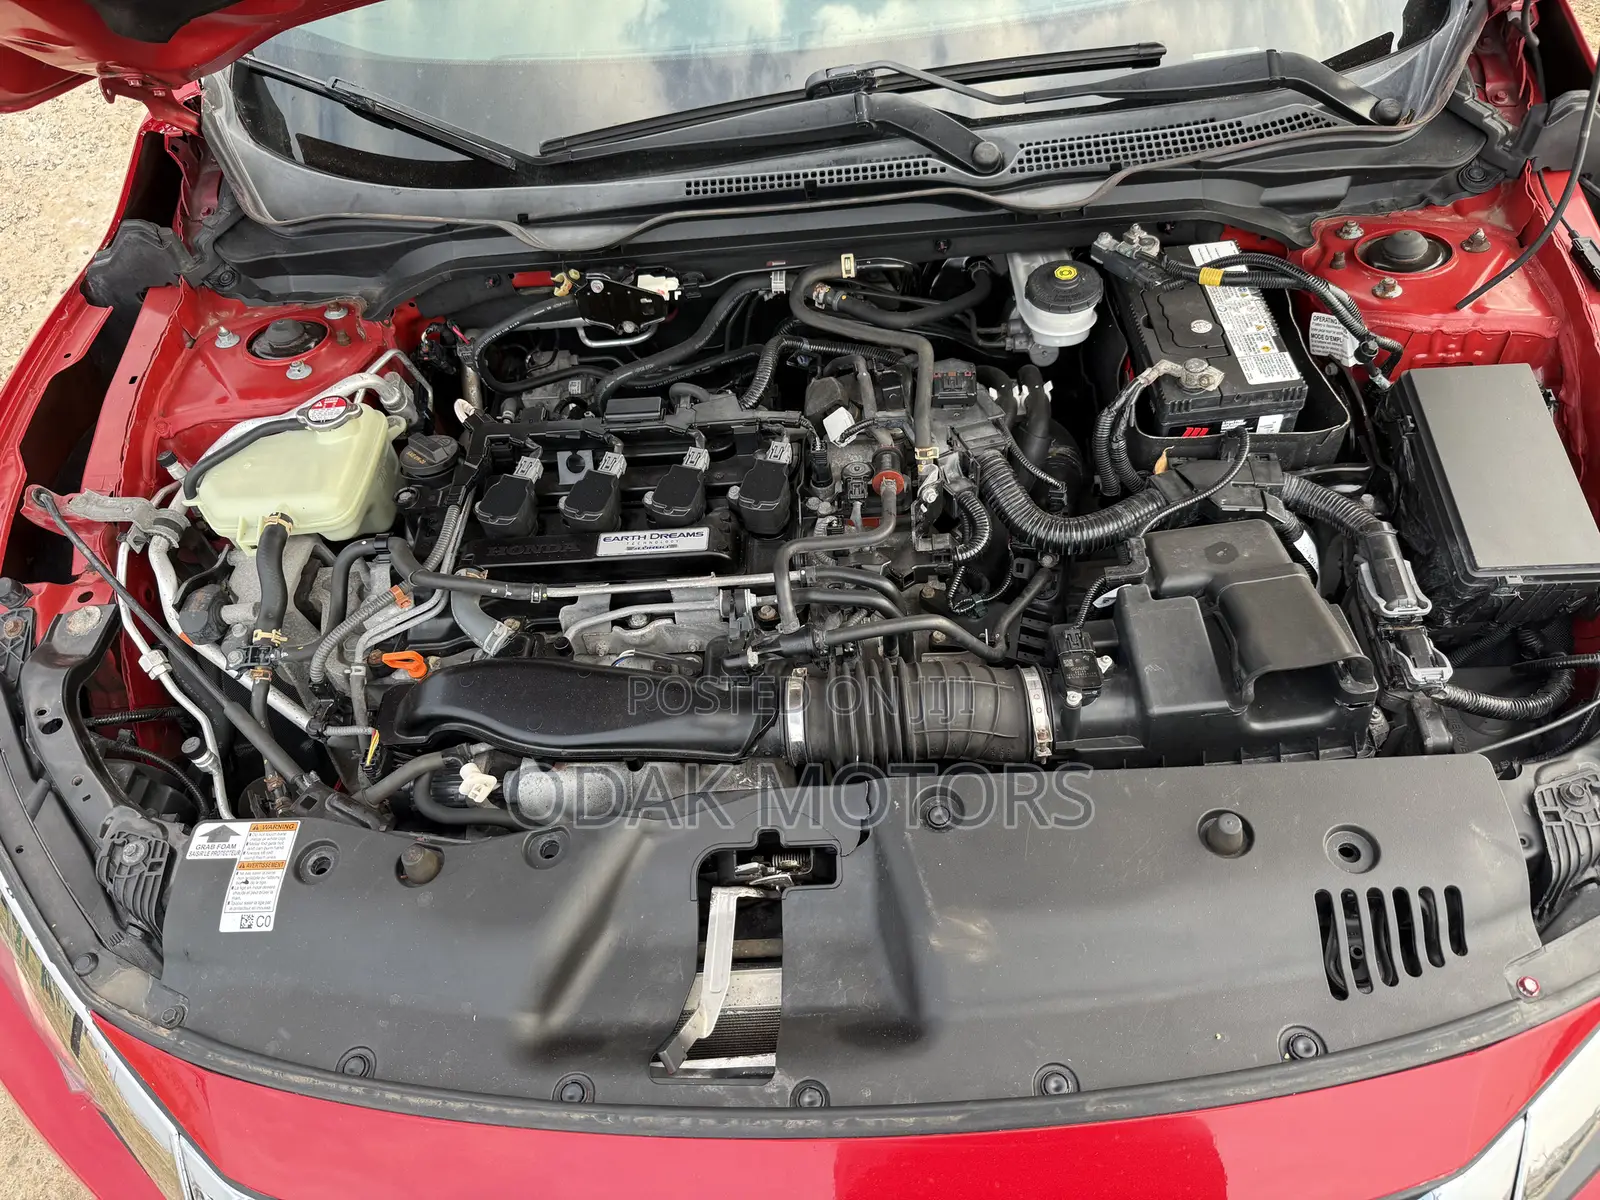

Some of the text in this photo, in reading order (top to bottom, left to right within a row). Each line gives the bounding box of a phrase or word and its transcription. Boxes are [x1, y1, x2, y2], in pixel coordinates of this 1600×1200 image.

[603, 531, 704, 543] EARTH DREAMS
[486, 543, 580, 556] HONDA
[262, 823, 294, 831] WARNING
[246, 861, 284, 869] AVERTISSEMENT
